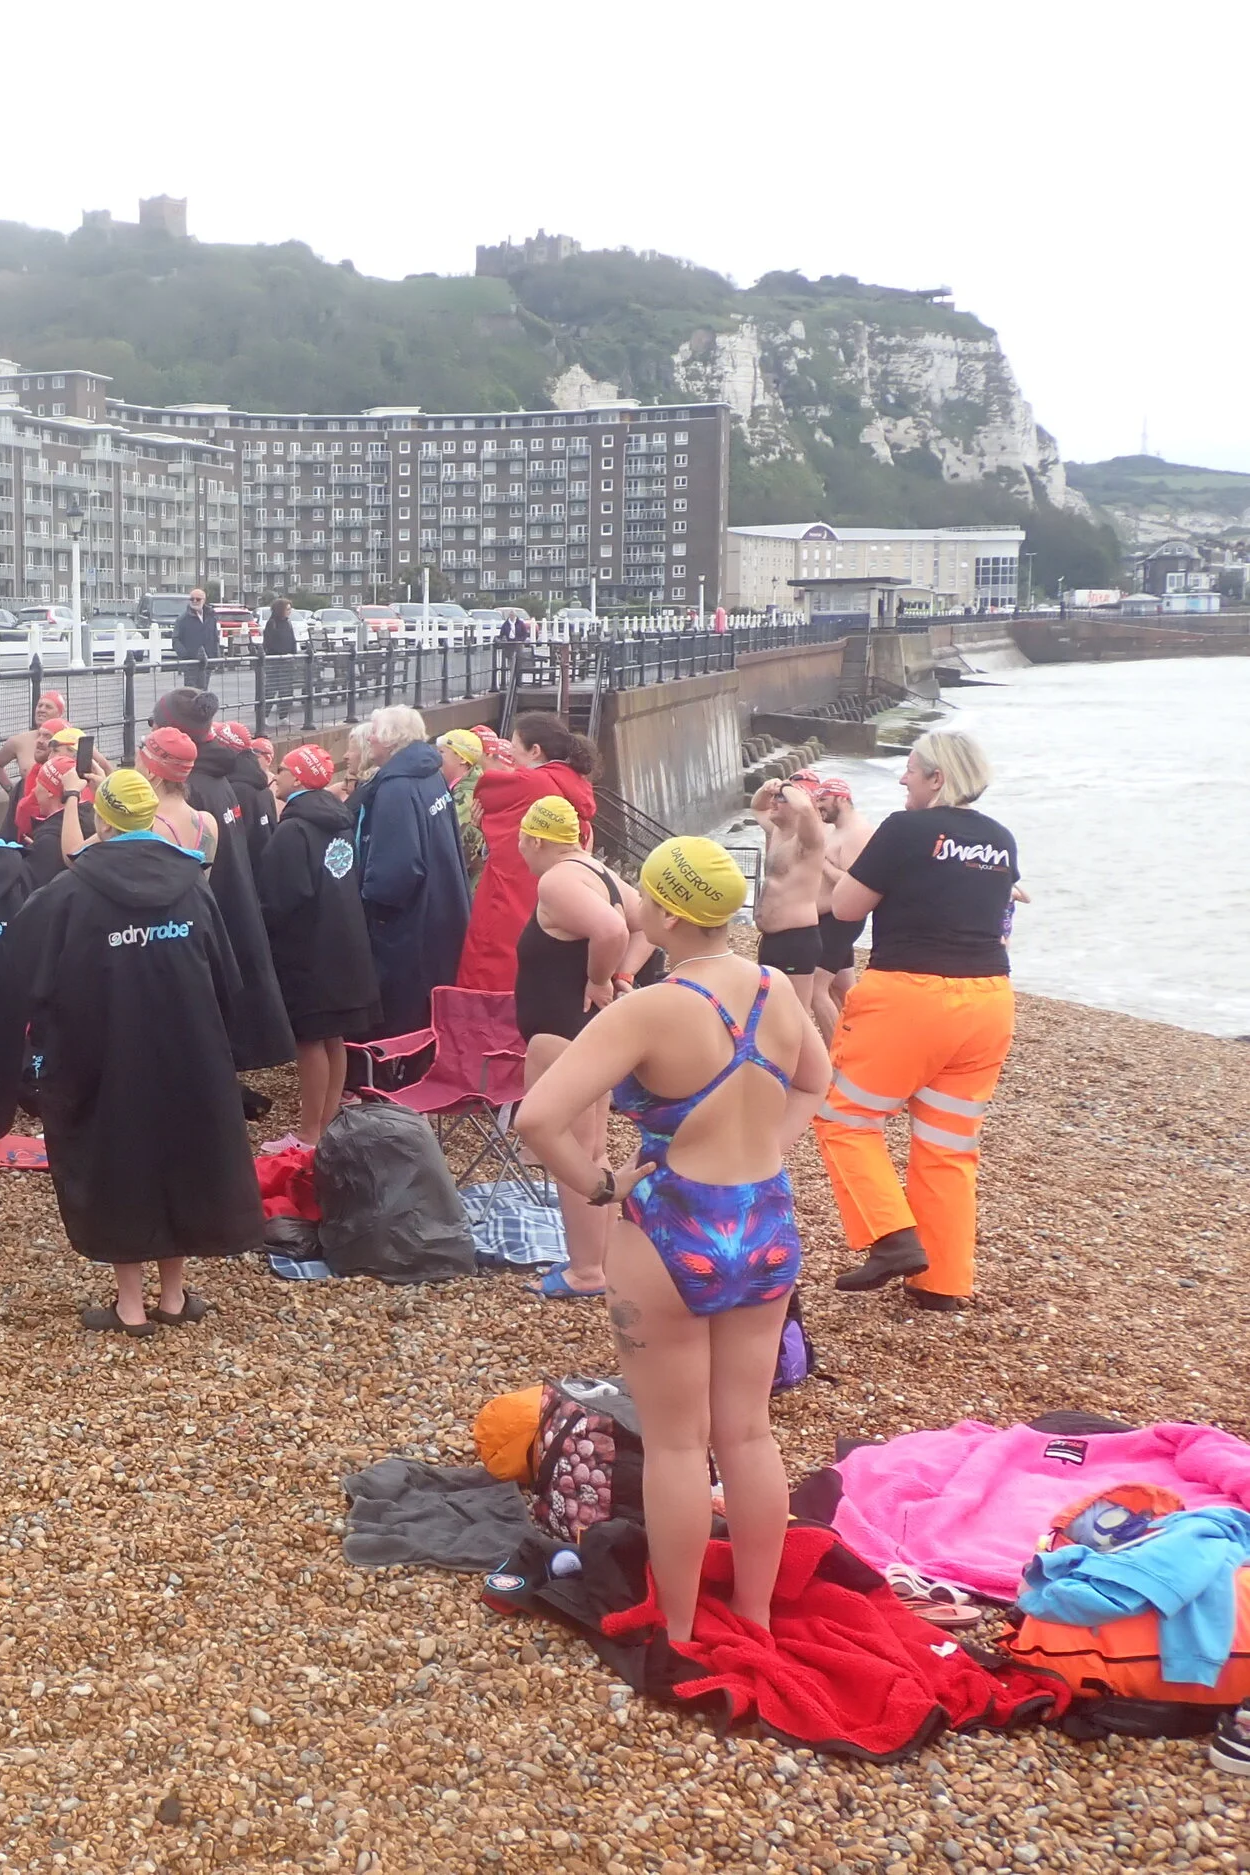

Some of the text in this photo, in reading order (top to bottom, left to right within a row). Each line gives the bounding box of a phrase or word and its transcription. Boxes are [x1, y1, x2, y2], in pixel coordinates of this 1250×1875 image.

[662, 867, 694, 902] WHEN
[670, 847, 723, 902] DANGEROUS
[122, 920, 190, 947] dryrobe
